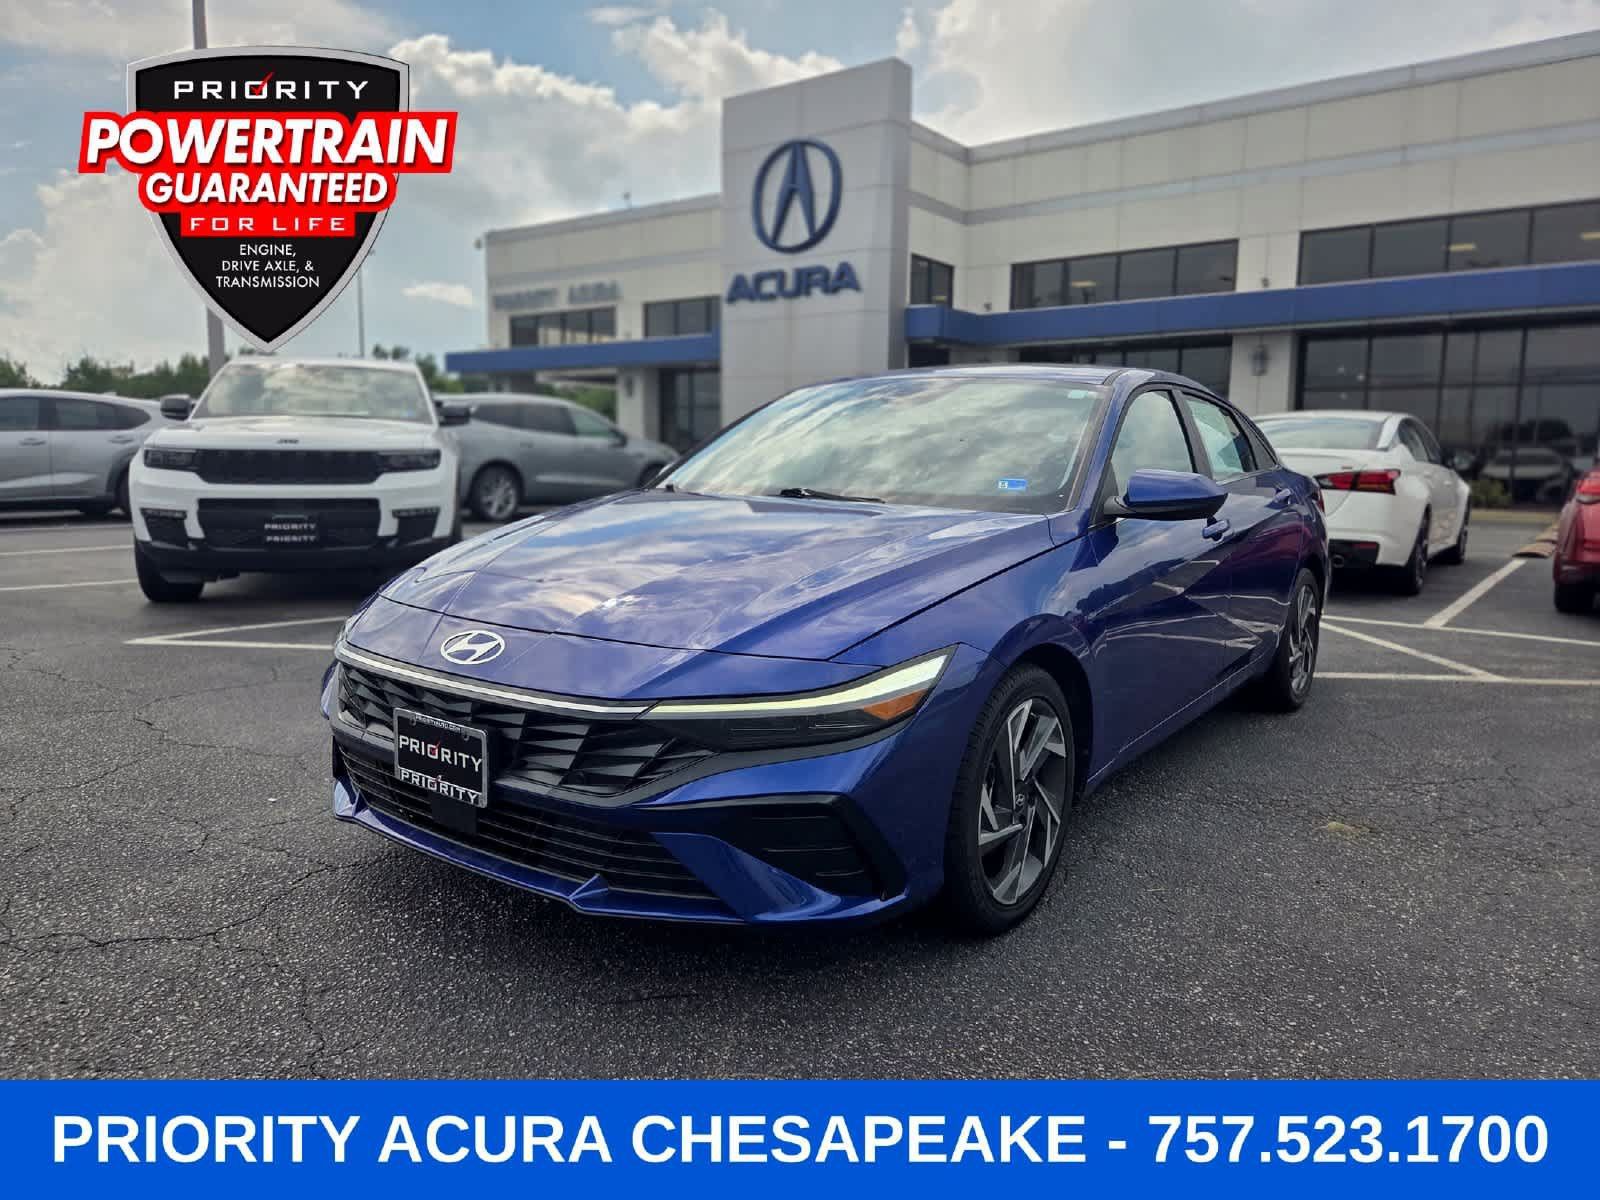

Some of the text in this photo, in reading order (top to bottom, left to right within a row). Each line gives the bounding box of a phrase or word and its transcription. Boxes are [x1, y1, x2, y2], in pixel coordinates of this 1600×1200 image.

[726, 261, 863, 304] ACURA
[399, 735, 482, 772] PRIORITY
[401, 770, 478, 804] PRIORITY
